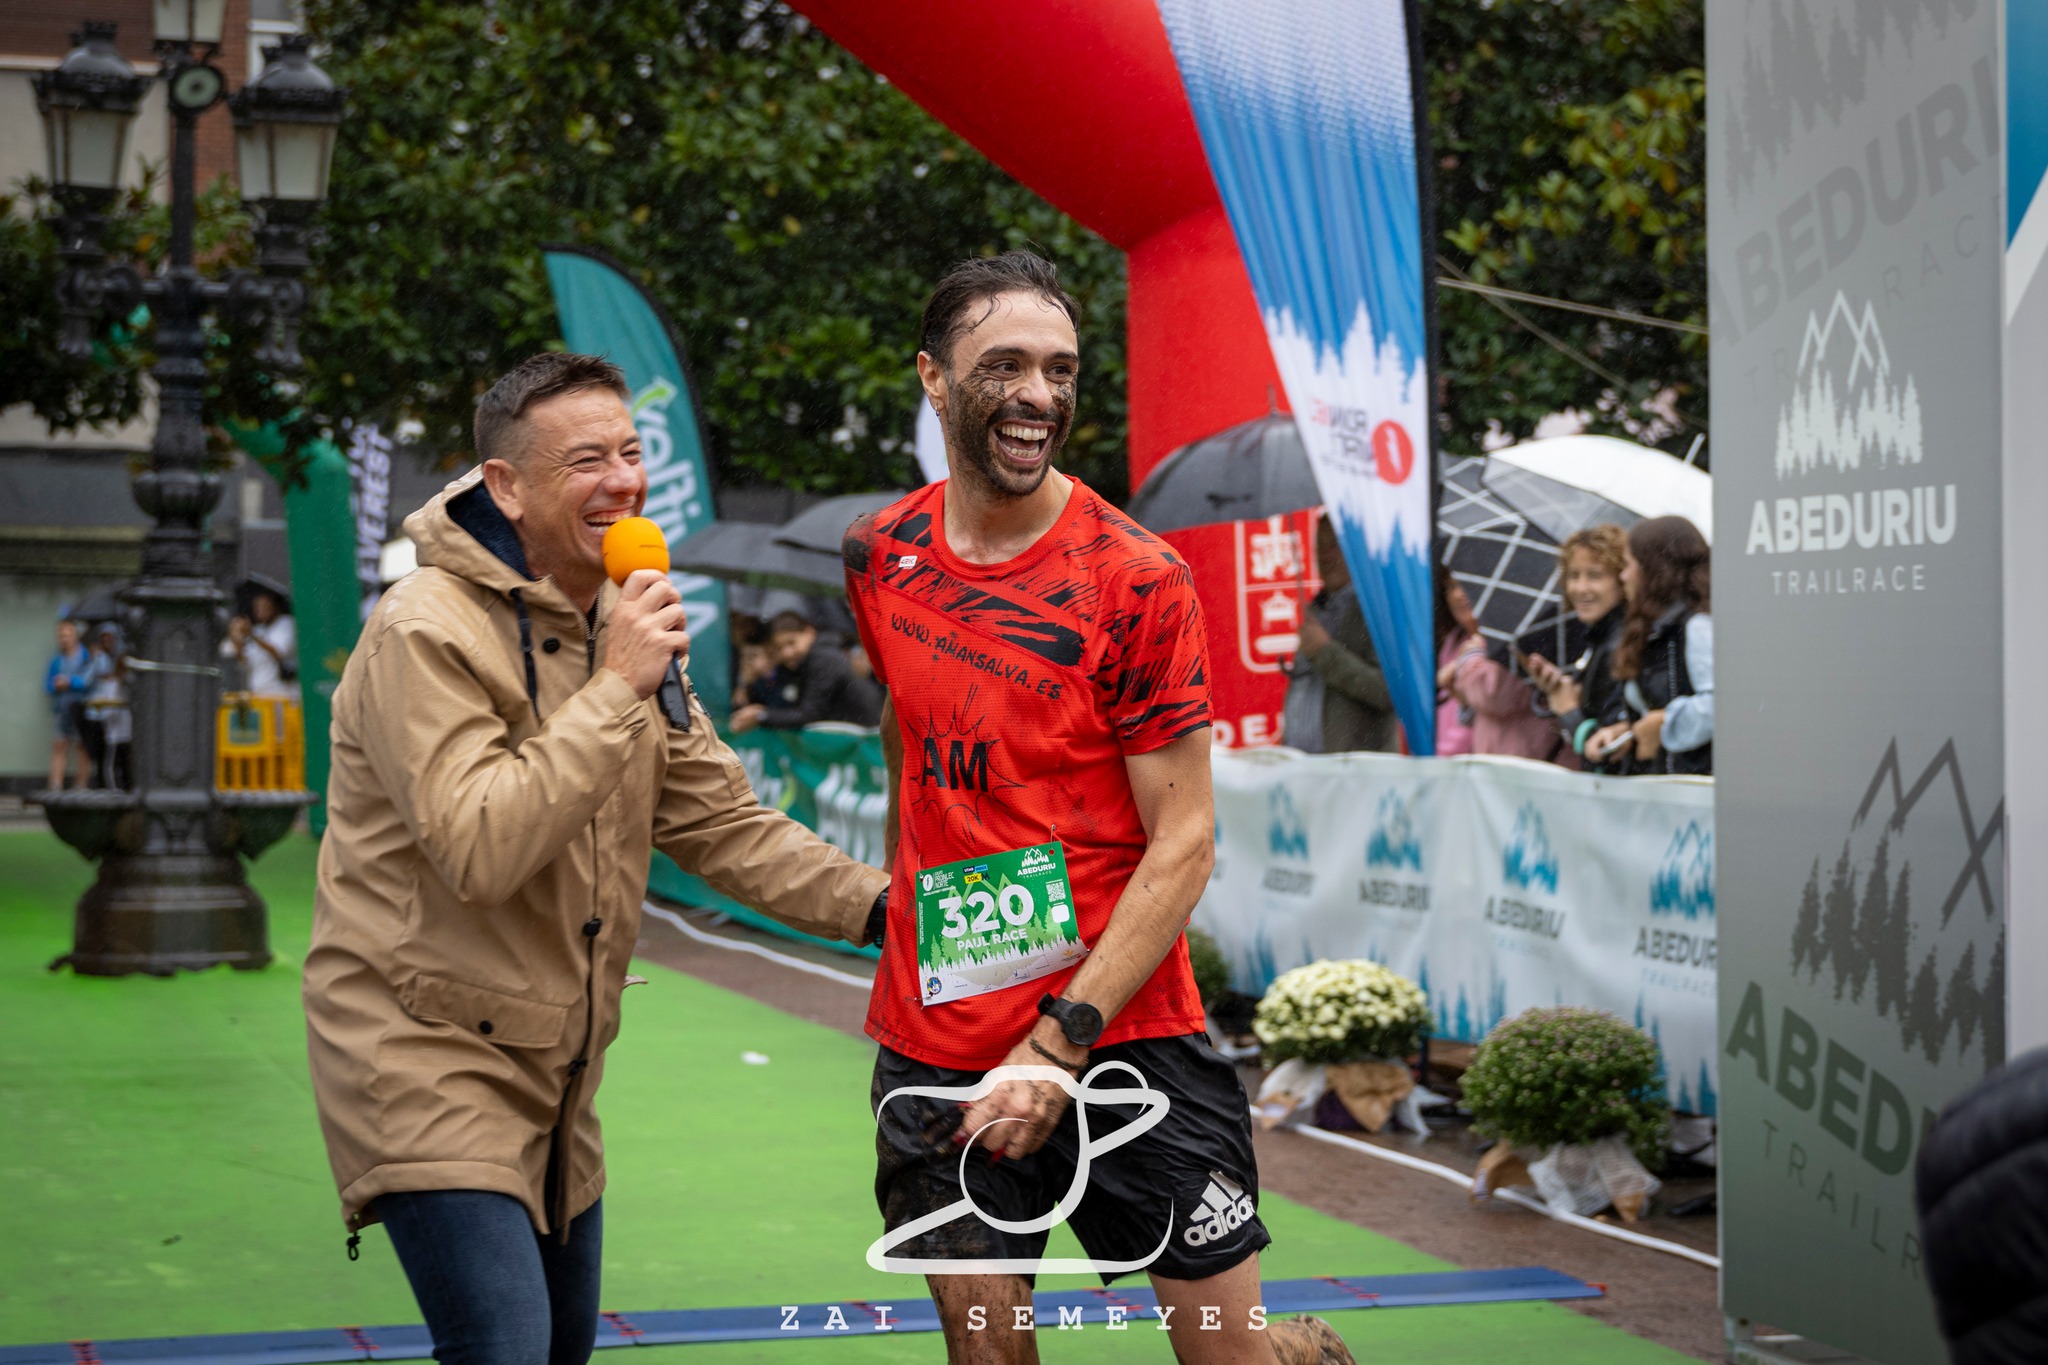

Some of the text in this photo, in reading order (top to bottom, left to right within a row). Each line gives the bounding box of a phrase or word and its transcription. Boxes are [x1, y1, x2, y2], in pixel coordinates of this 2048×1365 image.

[1746, 484, 1956, 555] ABEDURIU
[1771, 564, 1926, 595] TRAILRACE
[922, 736, 989, 793] AM
[966, 875, 980, 883] 20K
[1017, 862, 1056, 876] ABEDURIU
[938, 884, 1034, 938] 320
[957, 928, 1028, 951] PAUL RACE
[1725, 980, 1938, 1176] ABED
